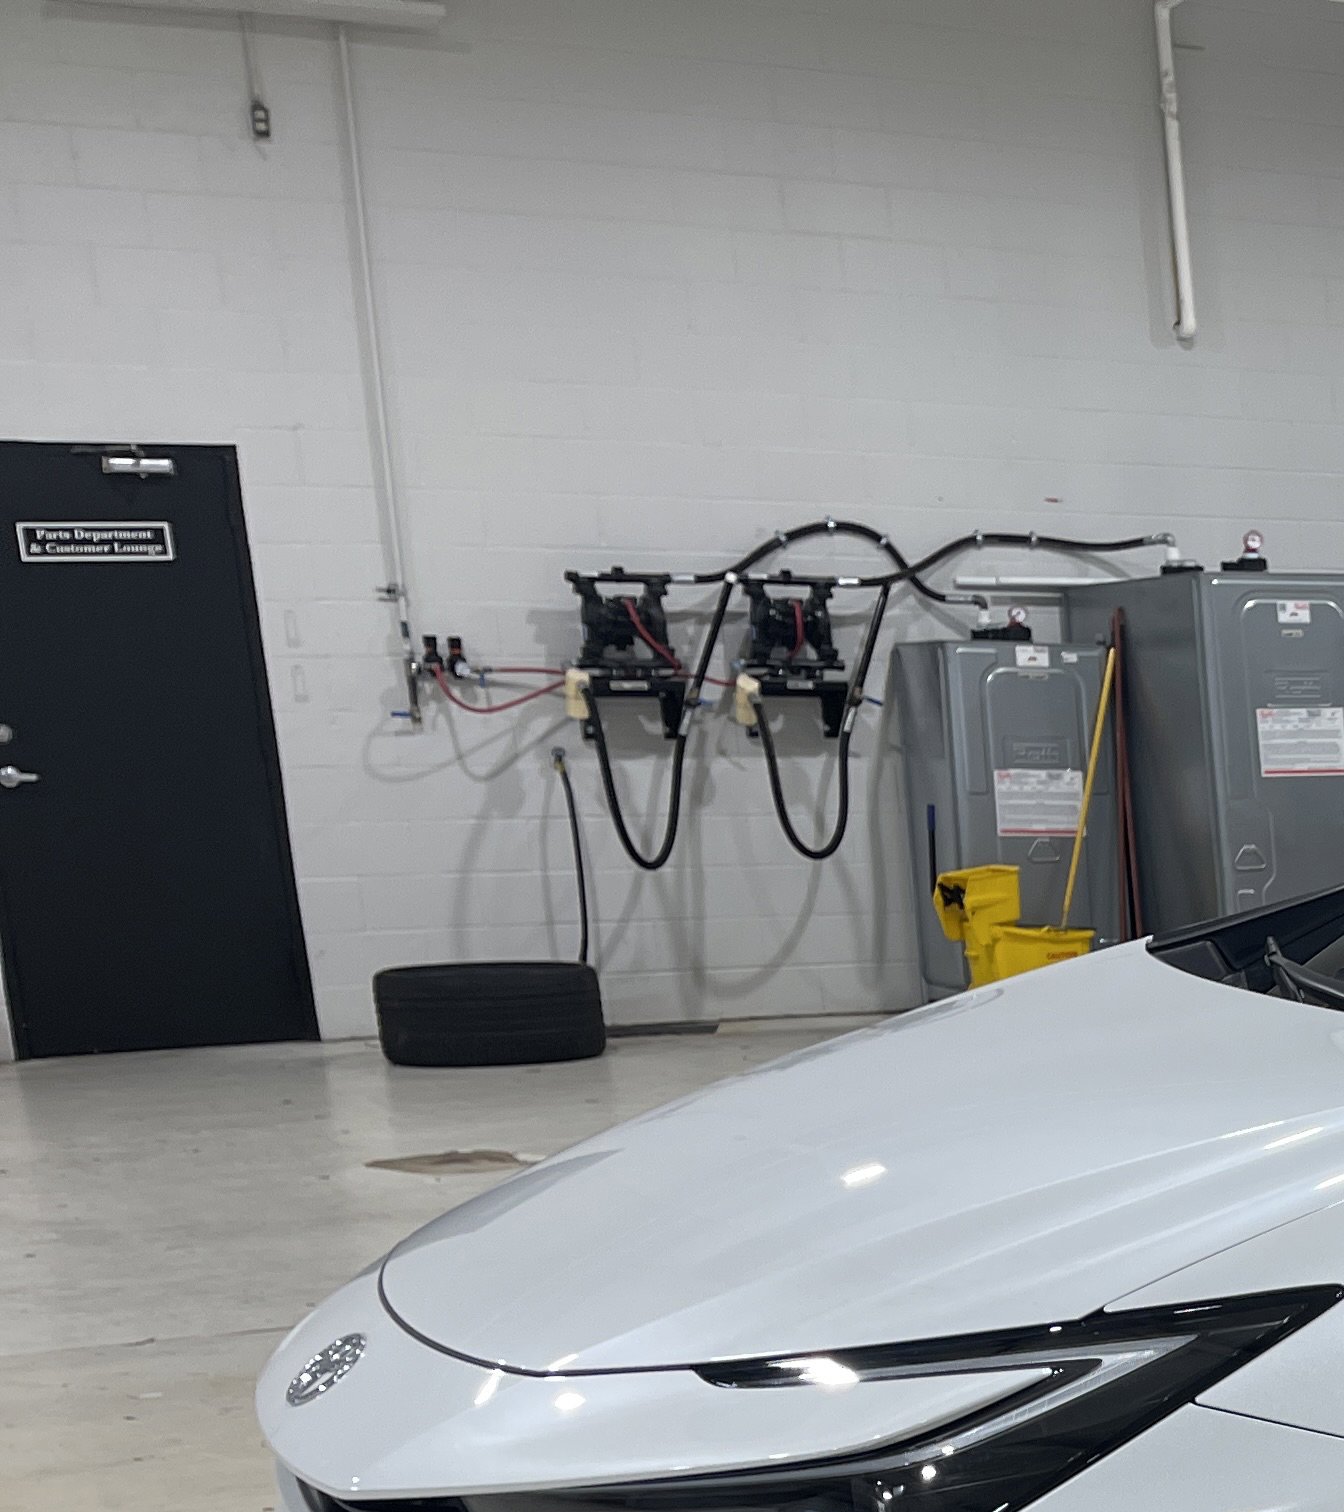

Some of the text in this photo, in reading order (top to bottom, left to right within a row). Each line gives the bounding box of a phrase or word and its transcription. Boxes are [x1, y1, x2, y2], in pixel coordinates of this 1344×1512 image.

[36, 529, 153, 543] Parts Department
[29, 542, 163, 556] & Customer Lounge
